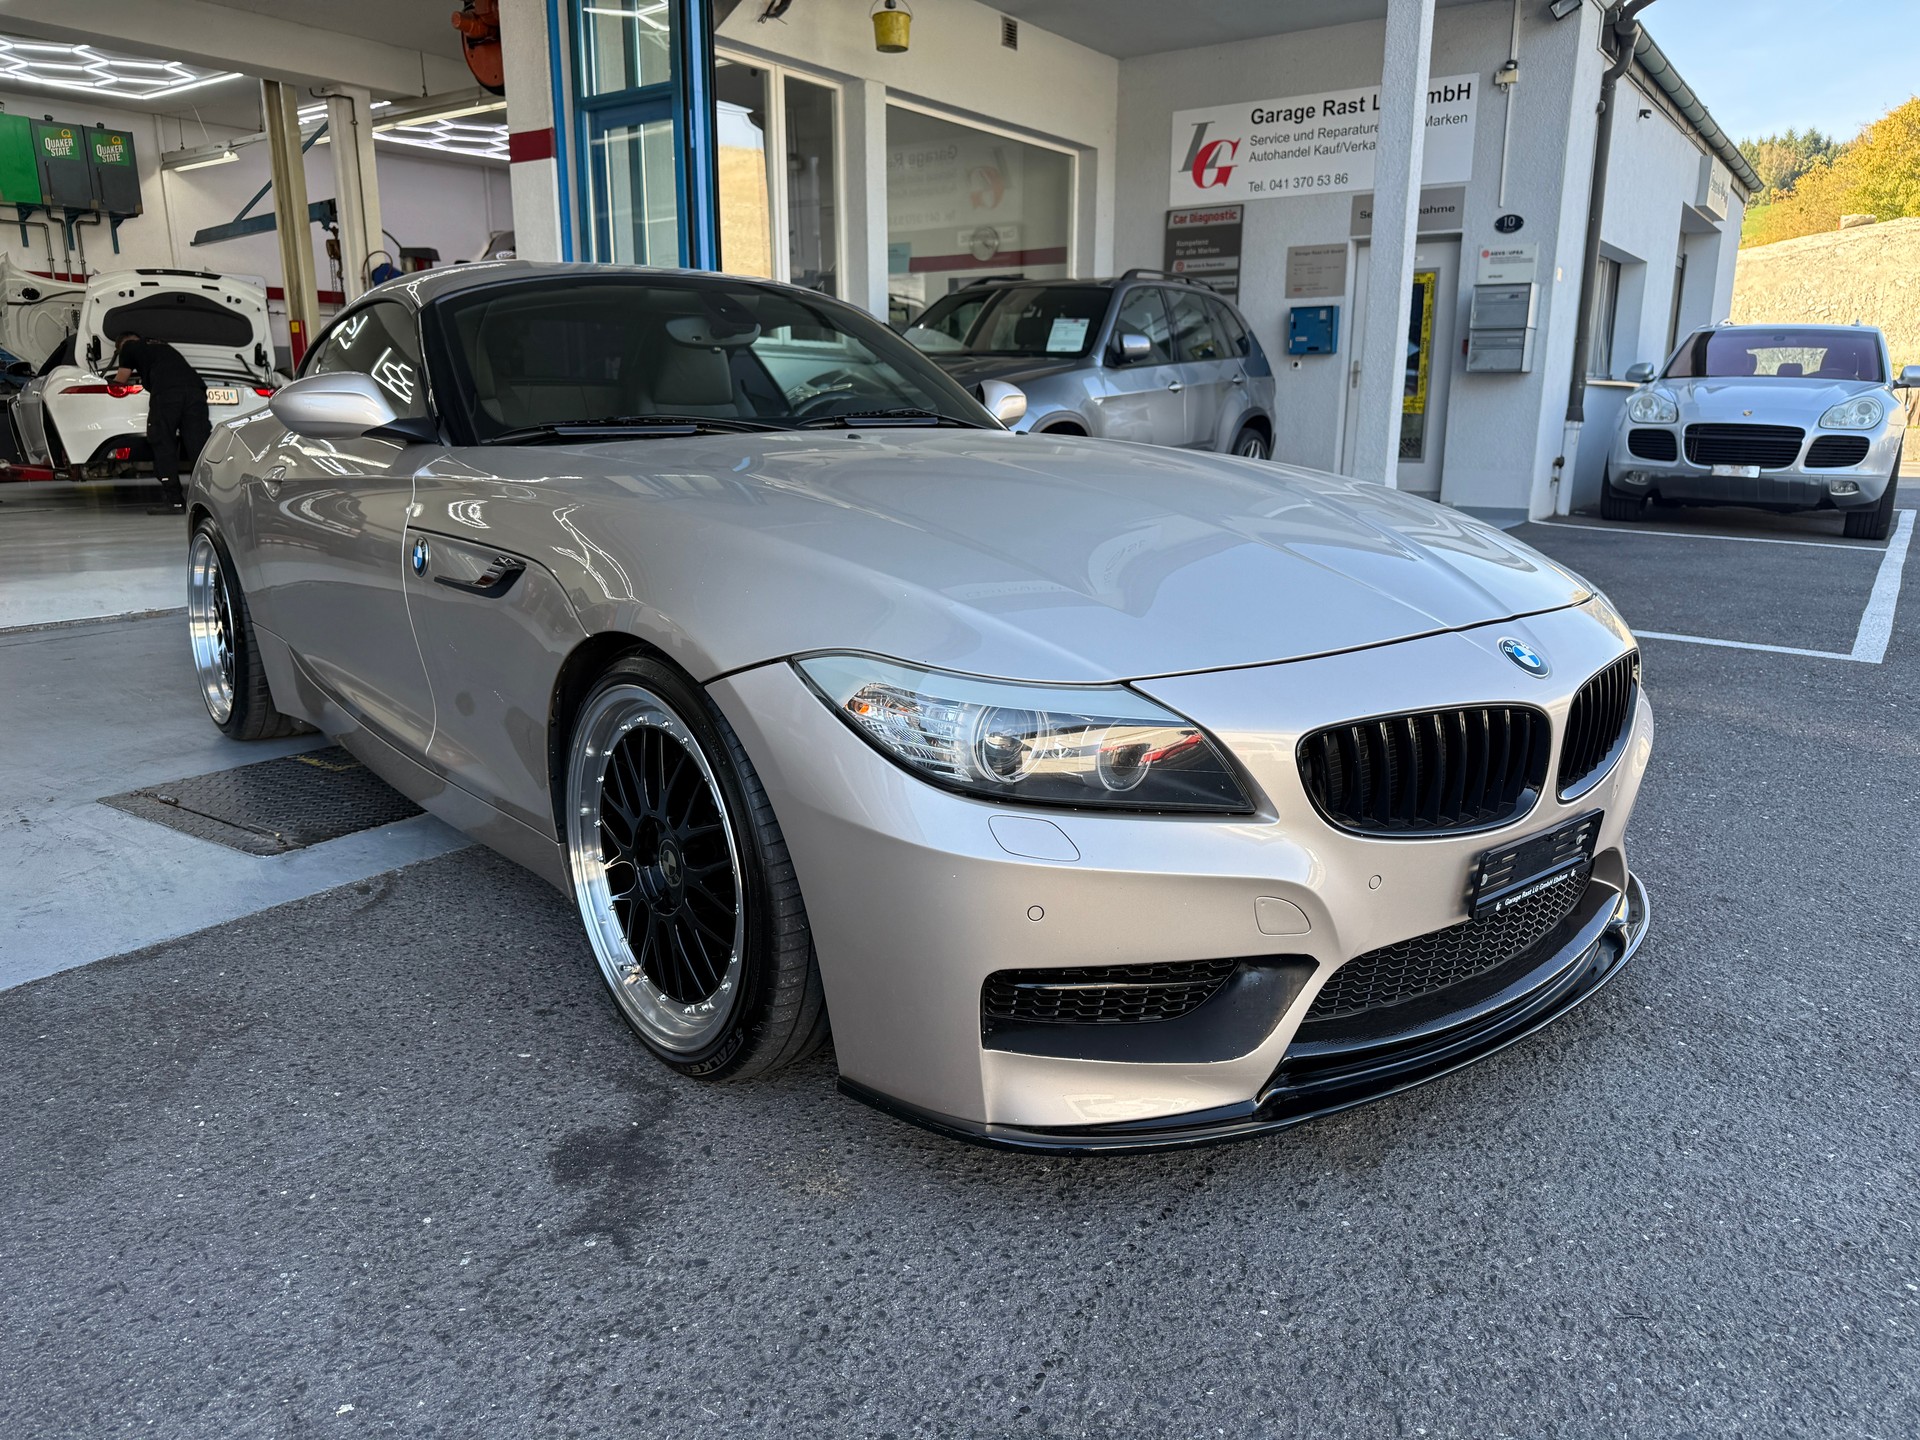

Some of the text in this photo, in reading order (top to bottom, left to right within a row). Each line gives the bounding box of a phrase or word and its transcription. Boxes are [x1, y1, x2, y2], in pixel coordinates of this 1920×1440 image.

[1251, 82, 1472, 125] Garage Rast L mbH
[45, 137, 74, 151] QUAKER
[1250, 133, 1290, 147] Service
[1293, 128, 1314, 142] und
[50, 147, 72, 157] STATE
[96, 144, 124, 157] QUAKER
[1249, 140, 1377, 162] Autohandel Kauf/Verka
[101, 153, 122, 163] STATE
[1248, 173, 1349, 192] Tel. 041 370 53 86
[1173, 210, 1237, 224] Car Diagnostic
[1360, 210, 1373, 219] Se
[1504, 216, 1516, 227] 10
[207, 390, 229, 401] 05-U
